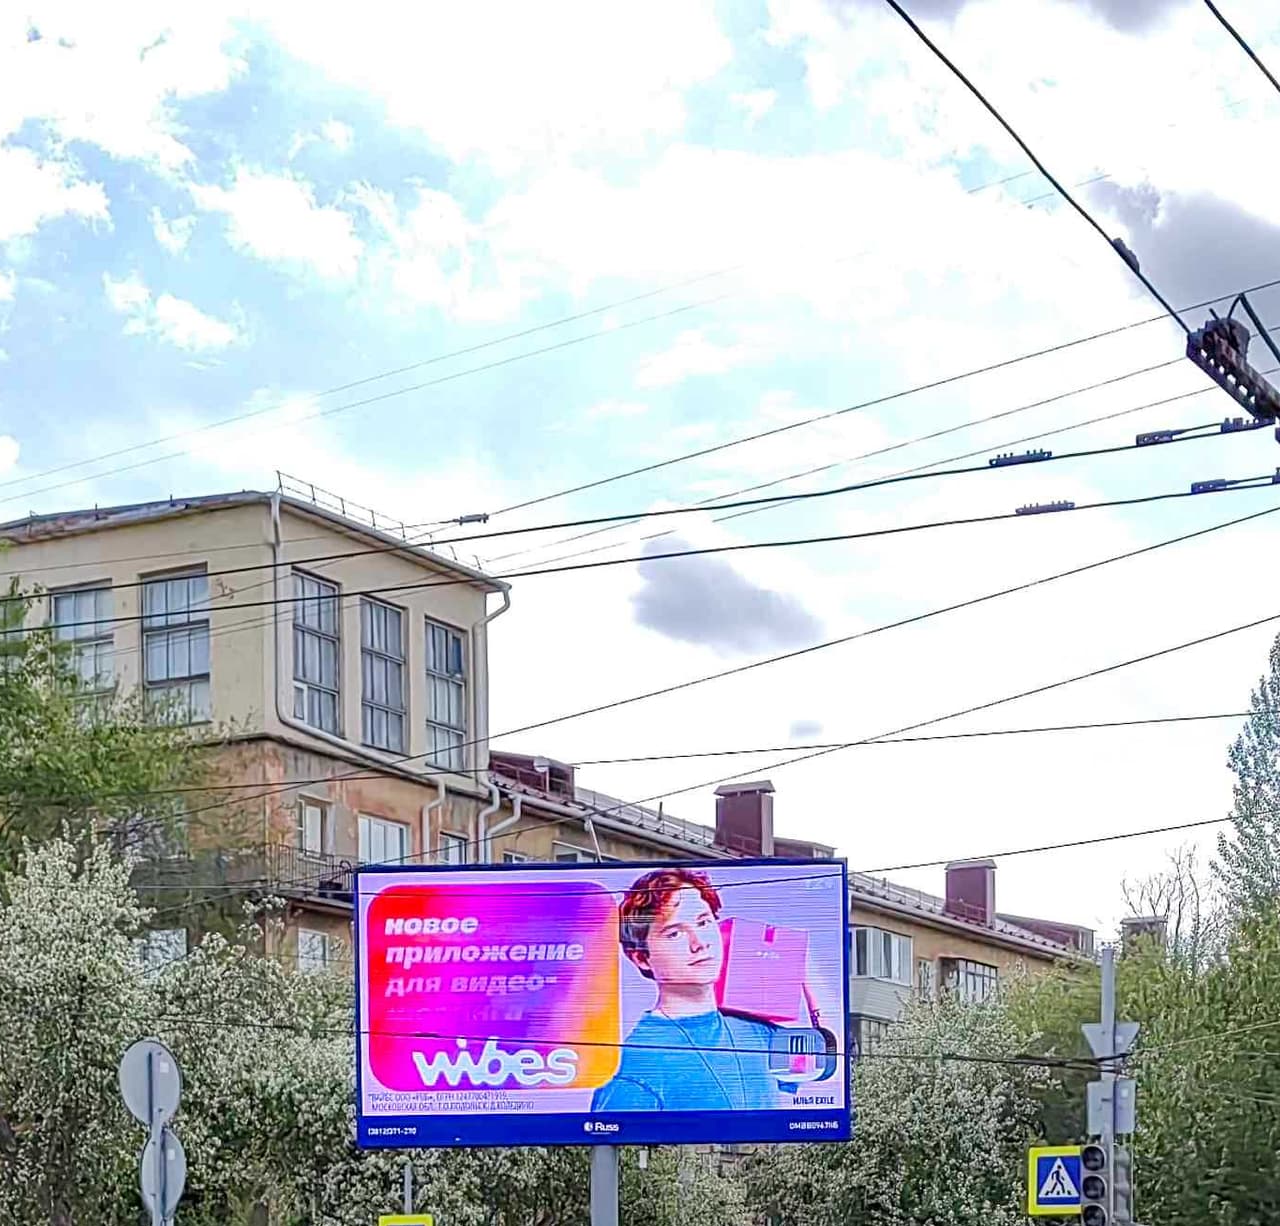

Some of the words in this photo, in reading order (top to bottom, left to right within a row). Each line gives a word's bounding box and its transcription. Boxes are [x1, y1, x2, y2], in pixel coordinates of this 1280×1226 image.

[384, 917, 479, 936] новое
[384, 943, 585, 970] приложение
[384, 976, 442, 997] для
[450, 974, 558, 996] видео-
[412, 1036, 579, 1087] wibes
[595, 1121, 619, 1132] Russ
